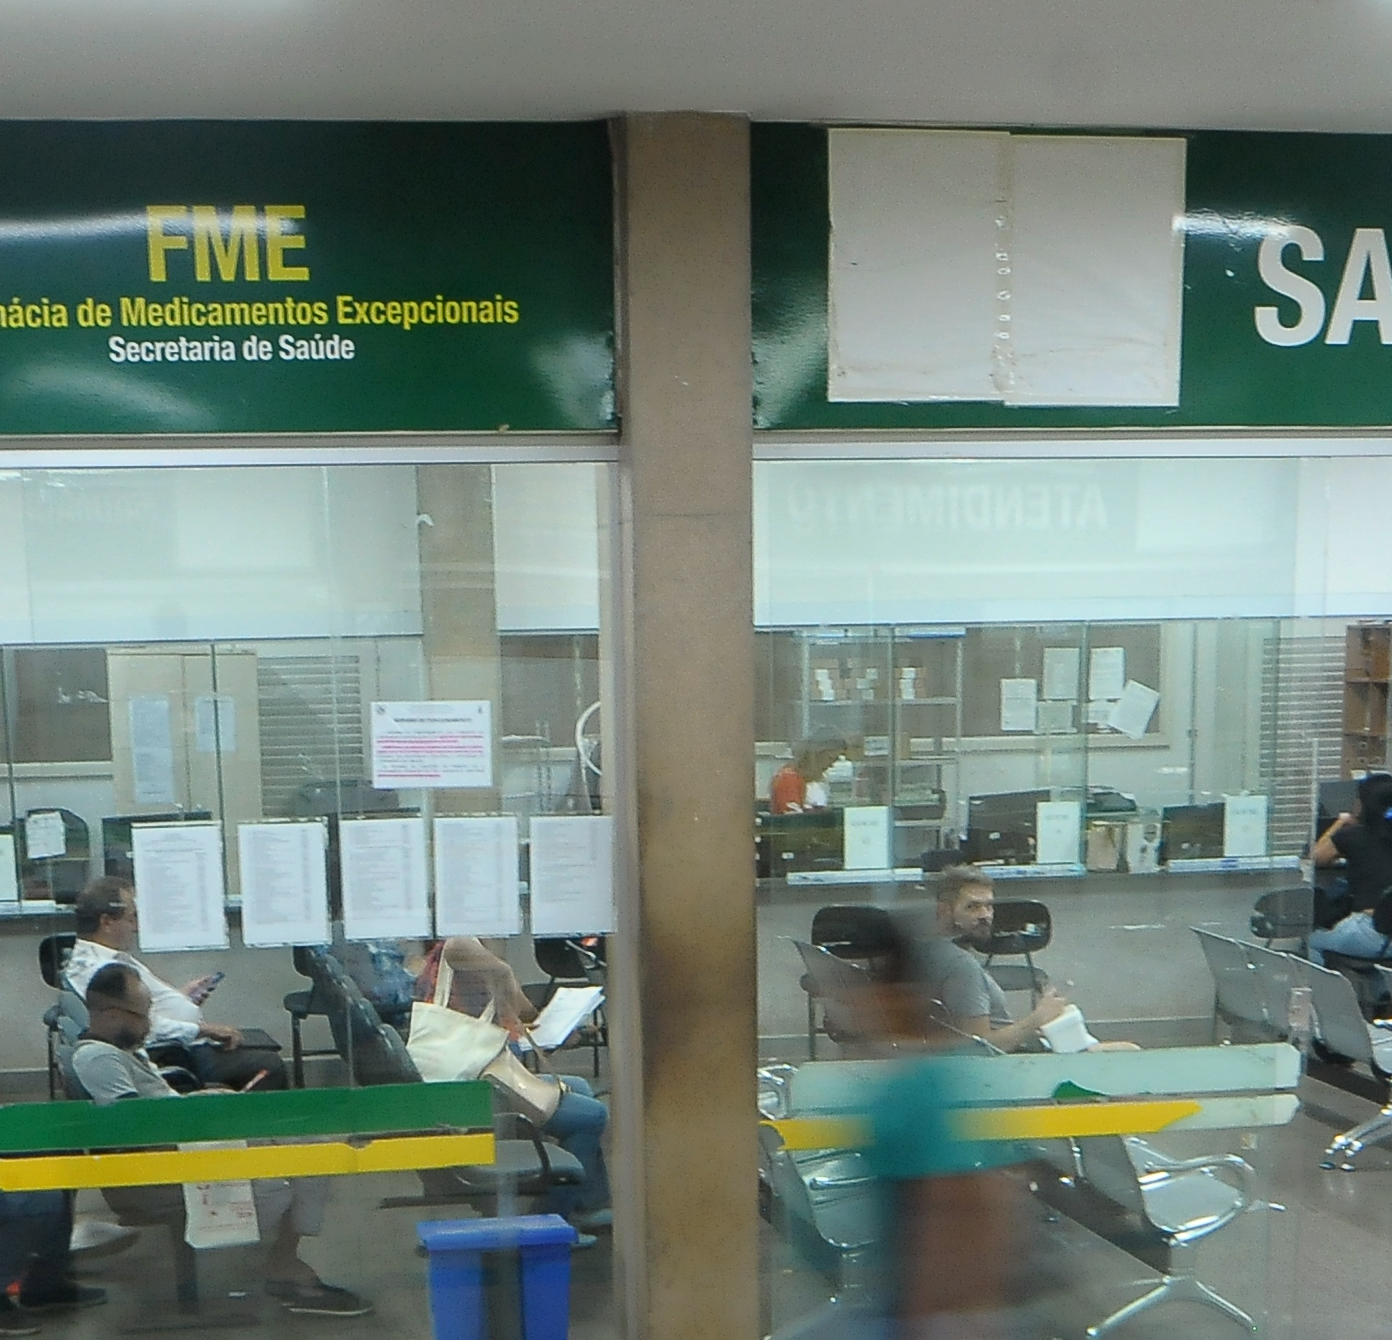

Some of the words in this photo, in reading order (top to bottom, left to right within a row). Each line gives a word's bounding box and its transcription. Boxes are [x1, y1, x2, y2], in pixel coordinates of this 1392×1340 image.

[146, 205, 310, 282] FME
[77, 297, 112, 328] de
[119, 297, 329, 327] Medicamentos
[336, 295, 519, 330] Excepcionais
[108, 334, 236, 364] Secretaria
[242, 335, 273, 362] de
[278, 333, 355, 363] Saúde
